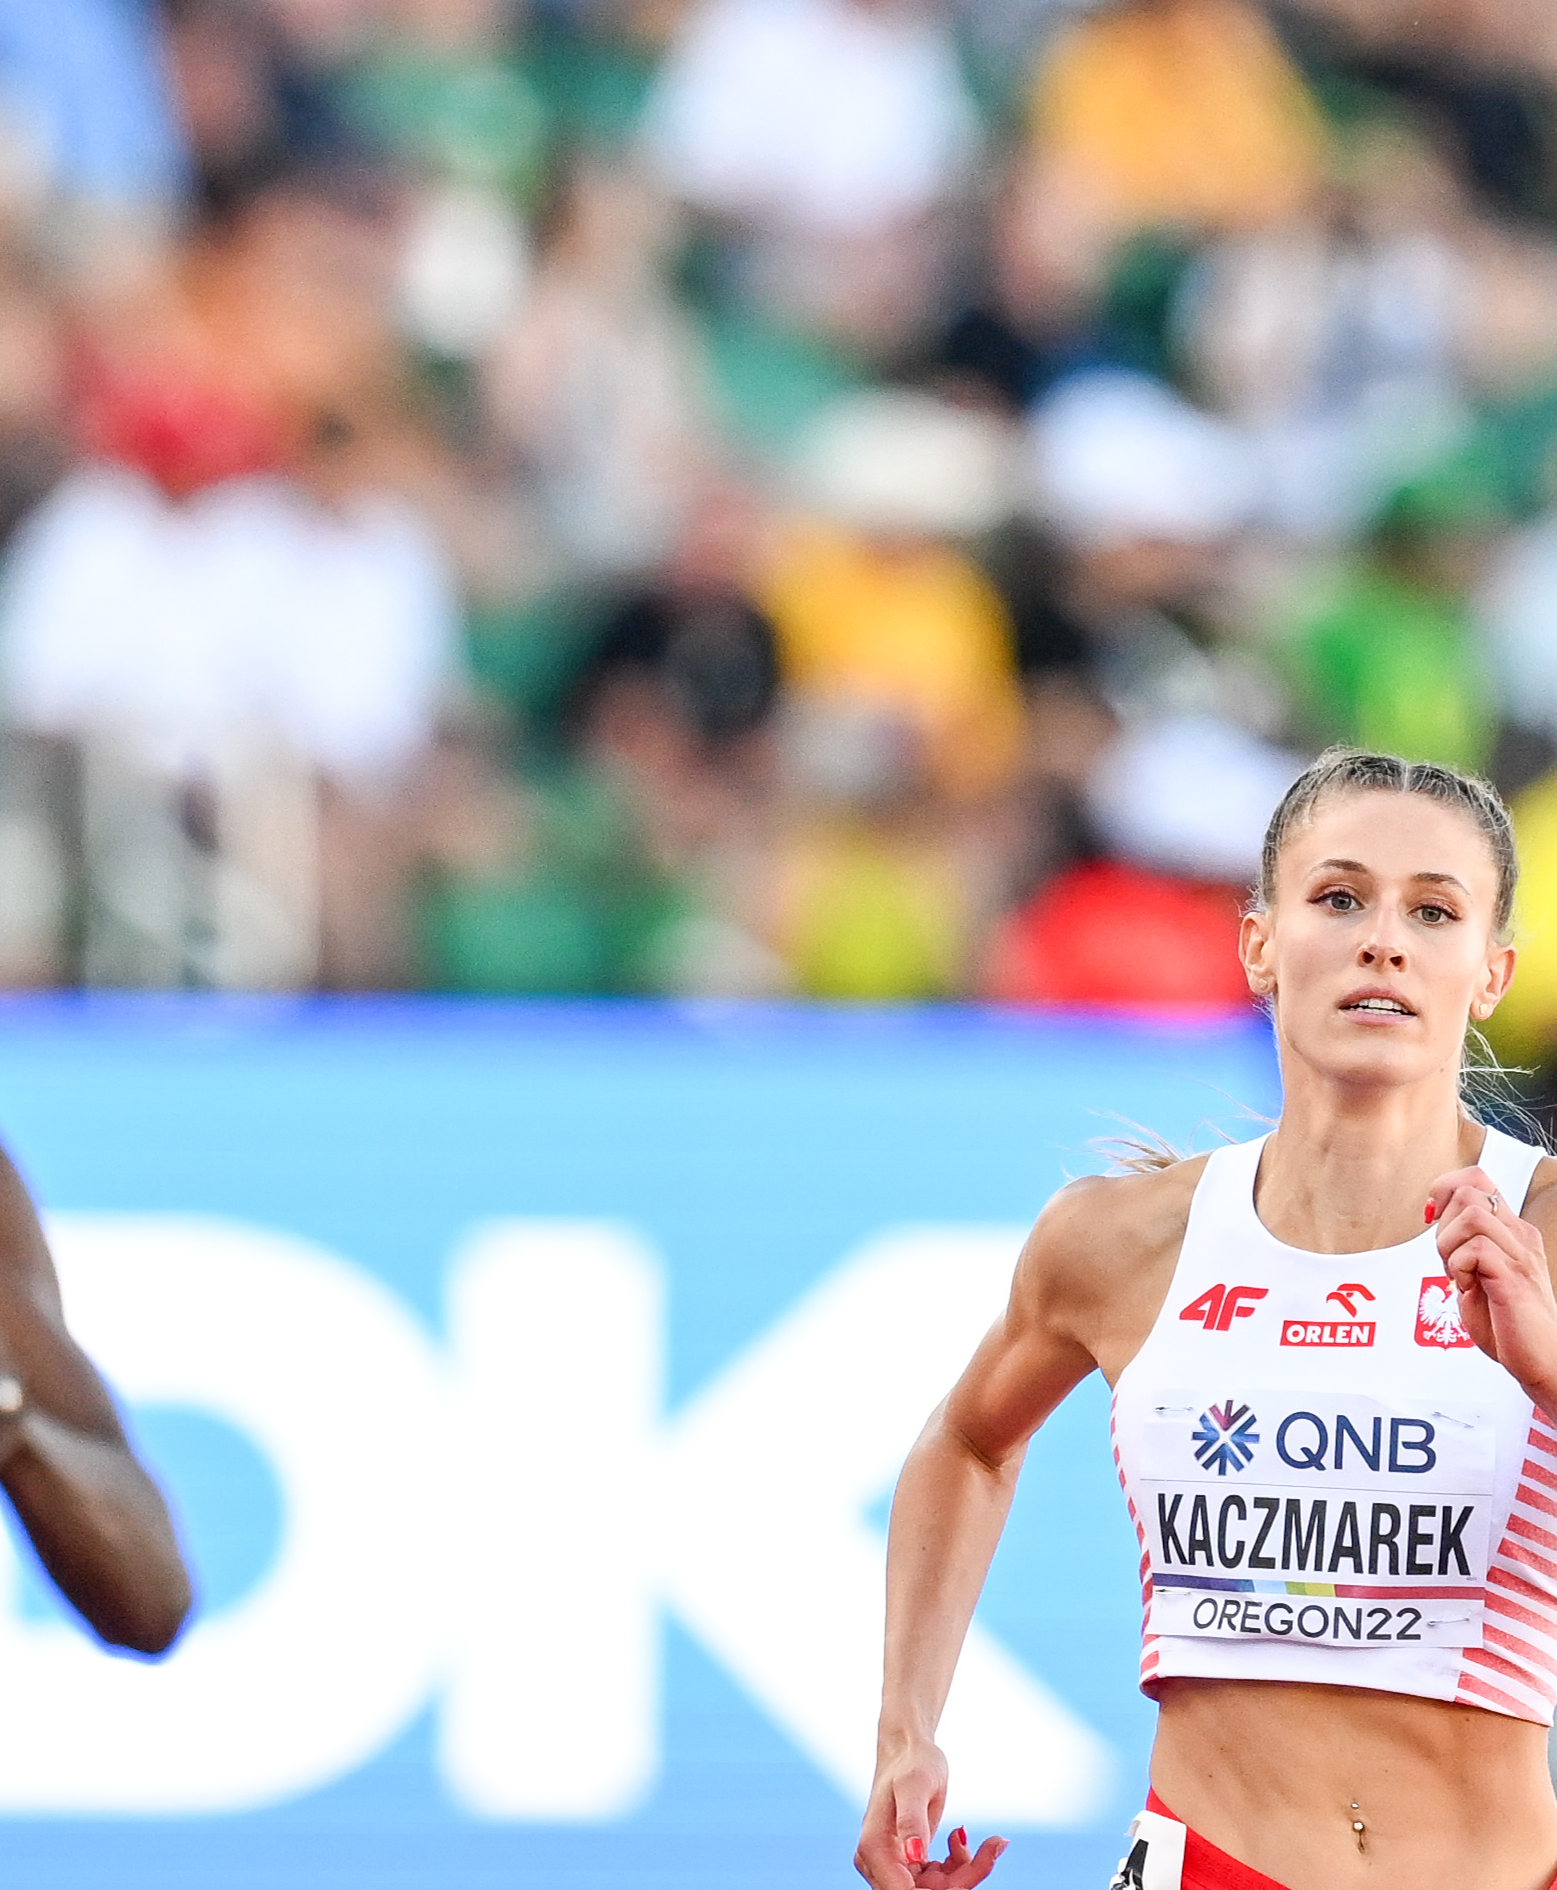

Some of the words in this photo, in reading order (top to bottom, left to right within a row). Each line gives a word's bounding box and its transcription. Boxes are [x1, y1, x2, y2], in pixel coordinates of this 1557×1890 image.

[1179, 1283, 1268, 1331] 4F
[1285, 1322, 1371, 1345] ORLEN
[1275, 1410, 1437, 1475] QNB
[1157, 1491, 1476, 1577] KACZMAREK
[1192, 1596, 1423, 1641] OREGON22
